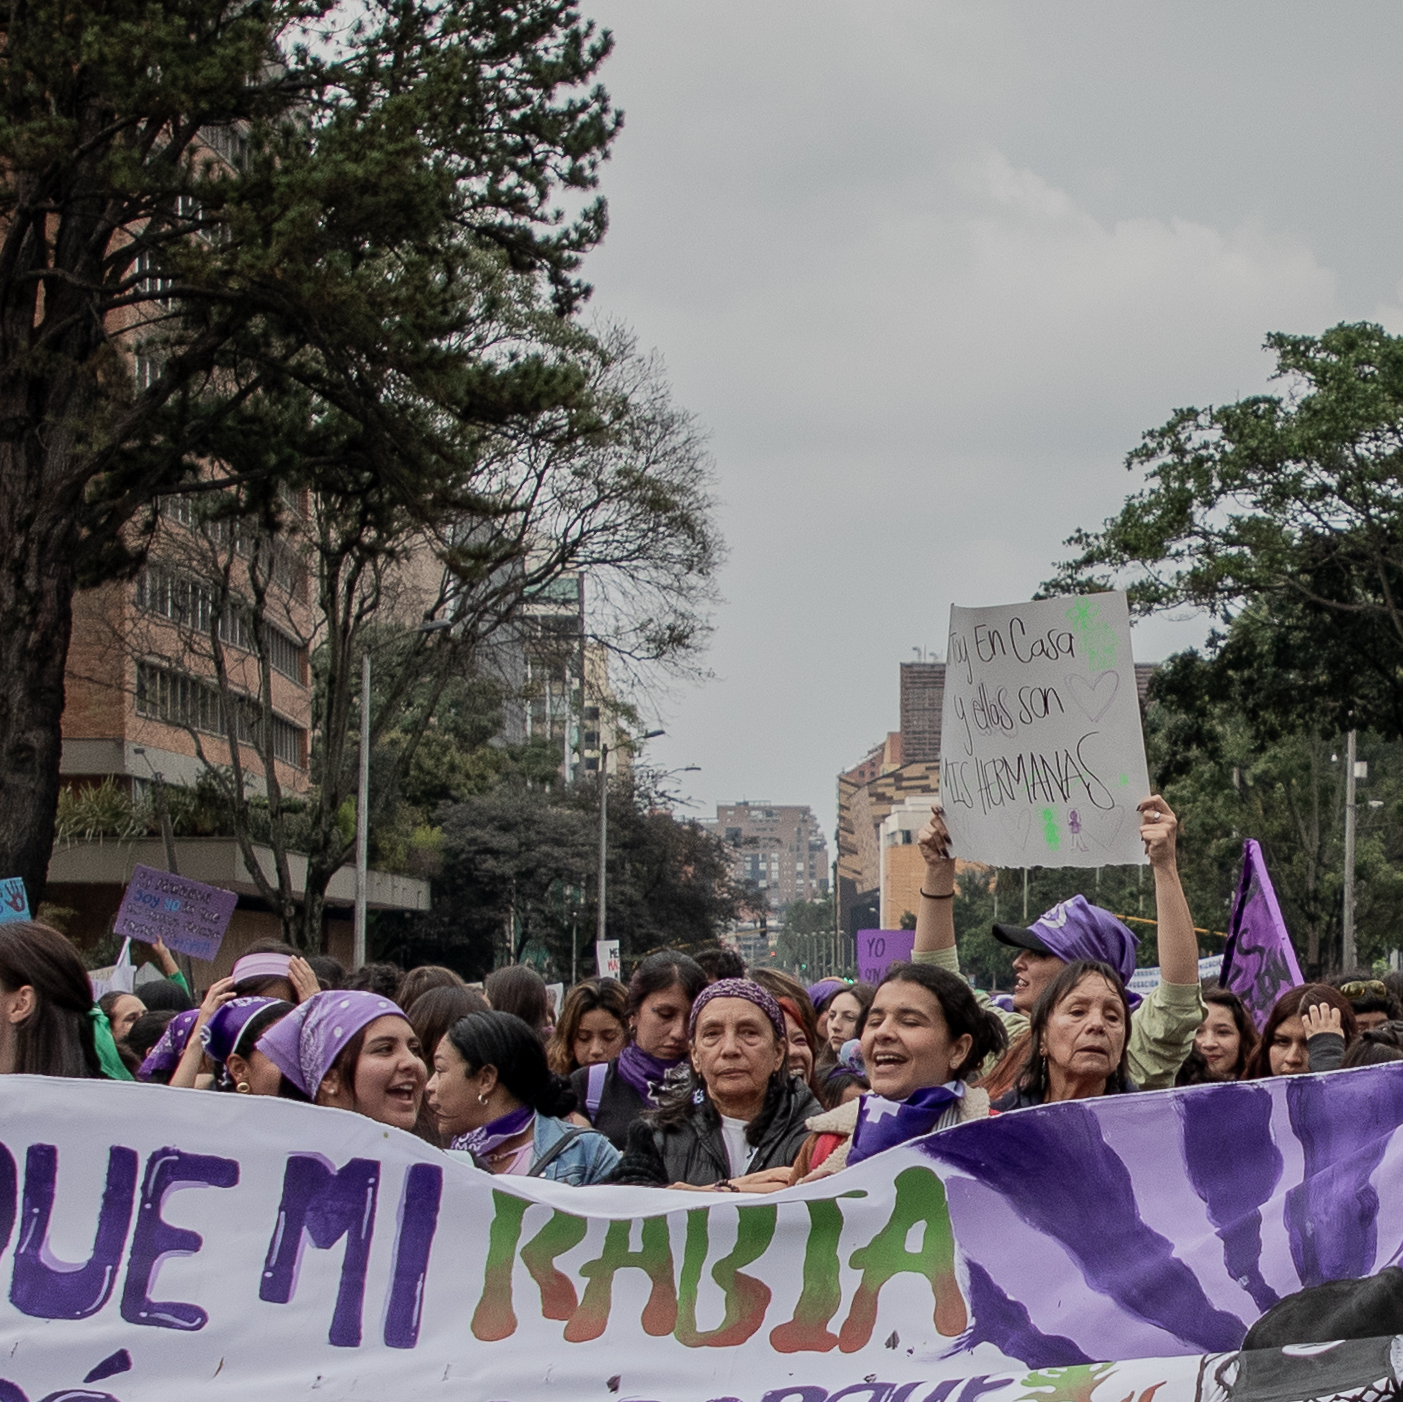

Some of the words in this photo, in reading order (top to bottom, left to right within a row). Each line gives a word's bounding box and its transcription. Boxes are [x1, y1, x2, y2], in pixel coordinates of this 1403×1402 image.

[1009, 617, 1076, 664] Casa
[1018, 685, 1065, 725] son
[977, 732, 1115, 815] HERMANAS
[867, 937, 885, 957] YO
[258, 1150, 443, 1349] MI
[470, 1165, 969, 1354] RABIA
